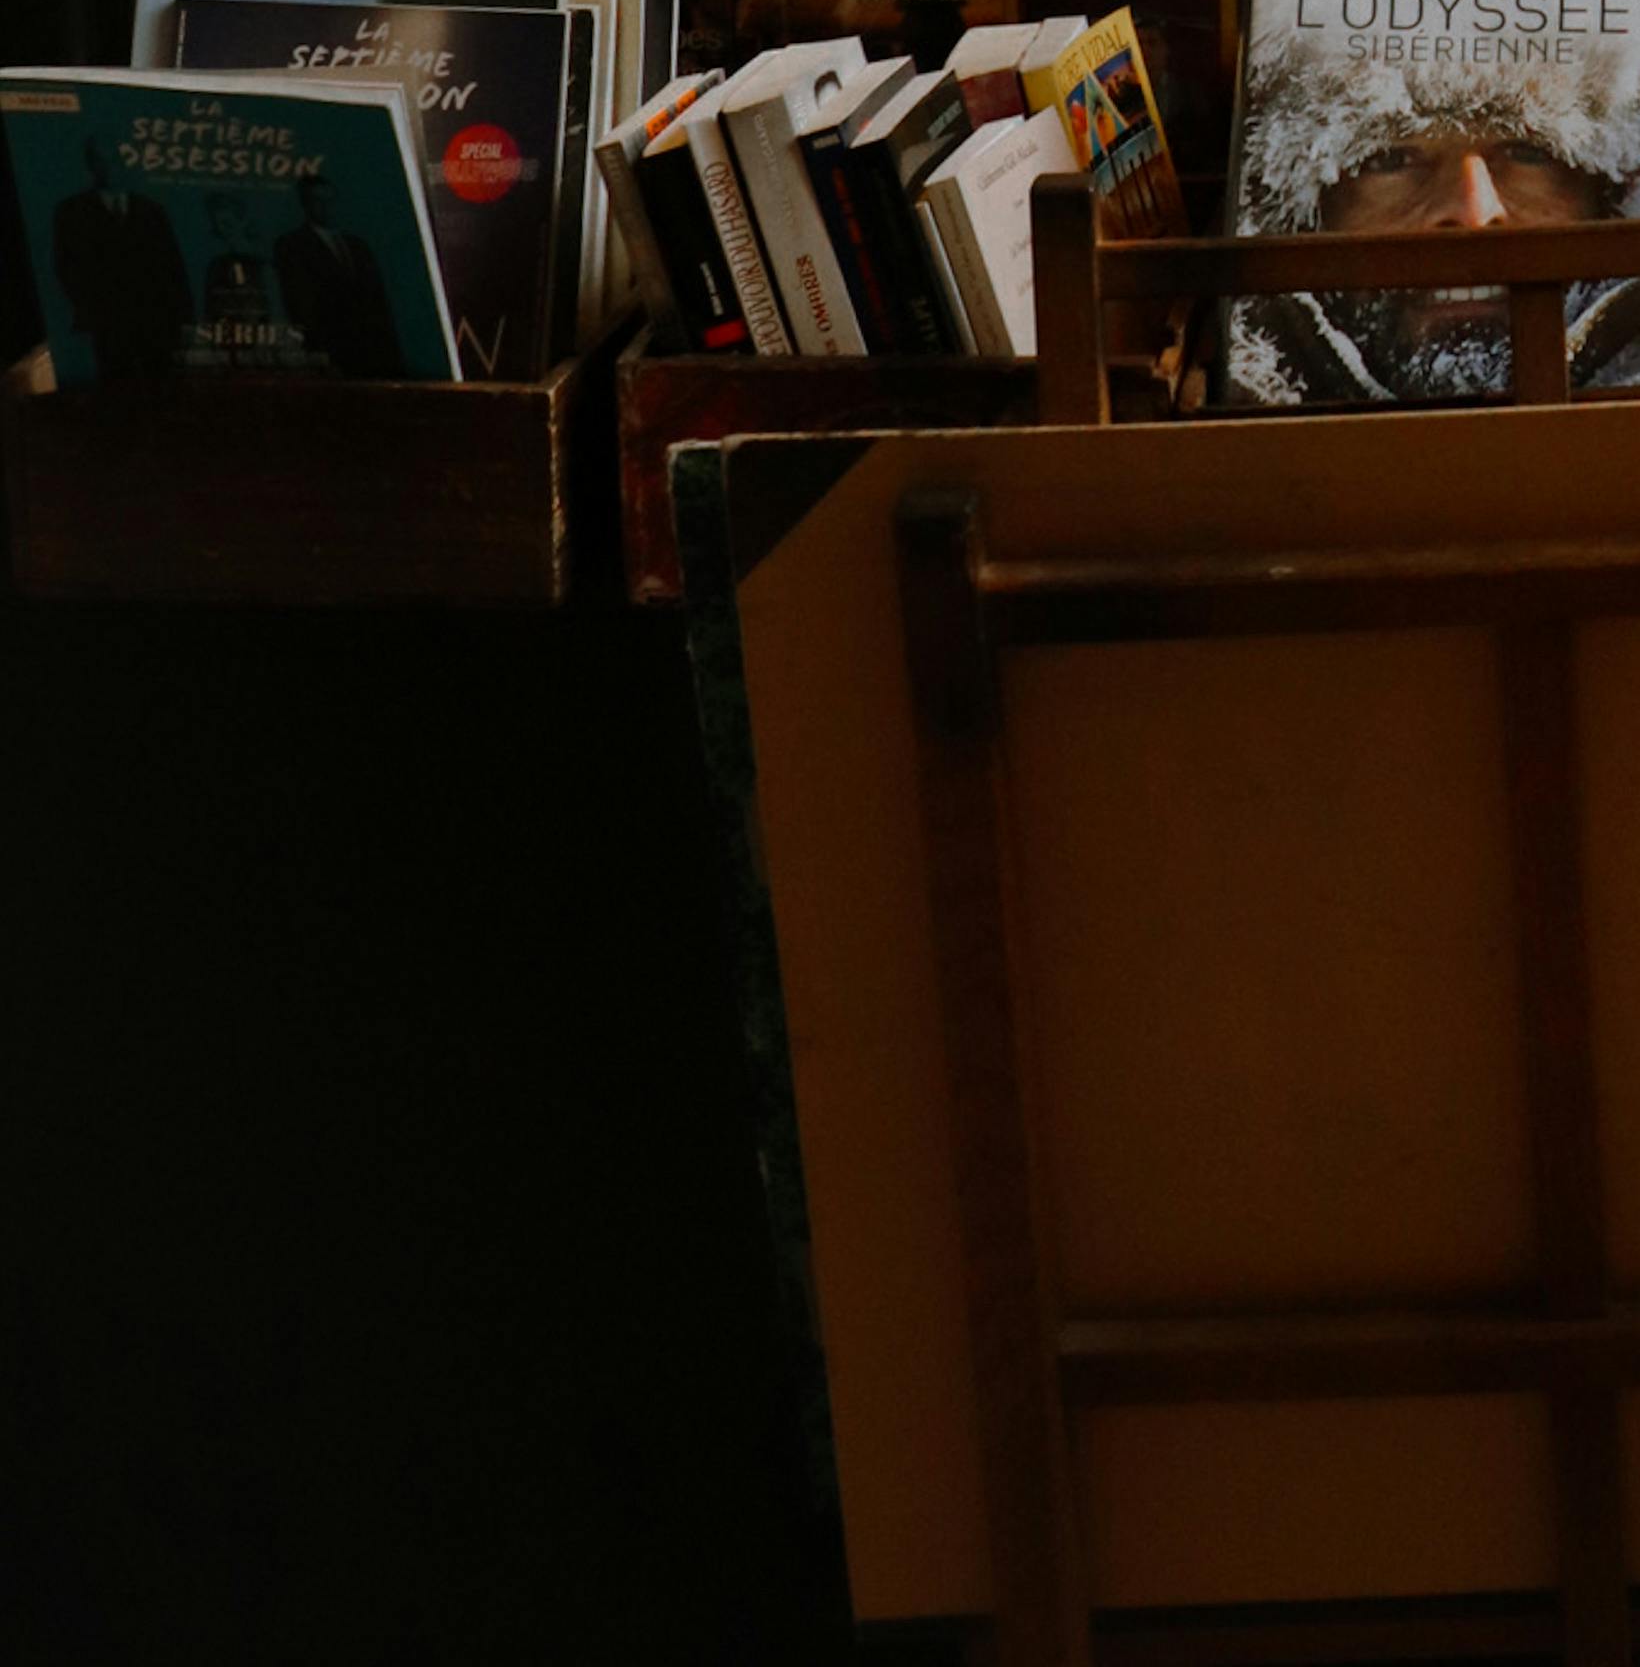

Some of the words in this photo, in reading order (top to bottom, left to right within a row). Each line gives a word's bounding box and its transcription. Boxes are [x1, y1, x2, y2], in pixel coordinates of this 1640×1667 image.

[354, 18, 391, 43] LA
[1347, 30, 1575, 65] SIBÉRIENNE
[286, 38, 456, 80] SEPTIÈME
[188, 98, 224, 118] LA
[131, 113, 297, 152] SEPTIÈME
[117, 140, 326, 179] OBSESSION
[797, 253, 833, 336] OMBRES
